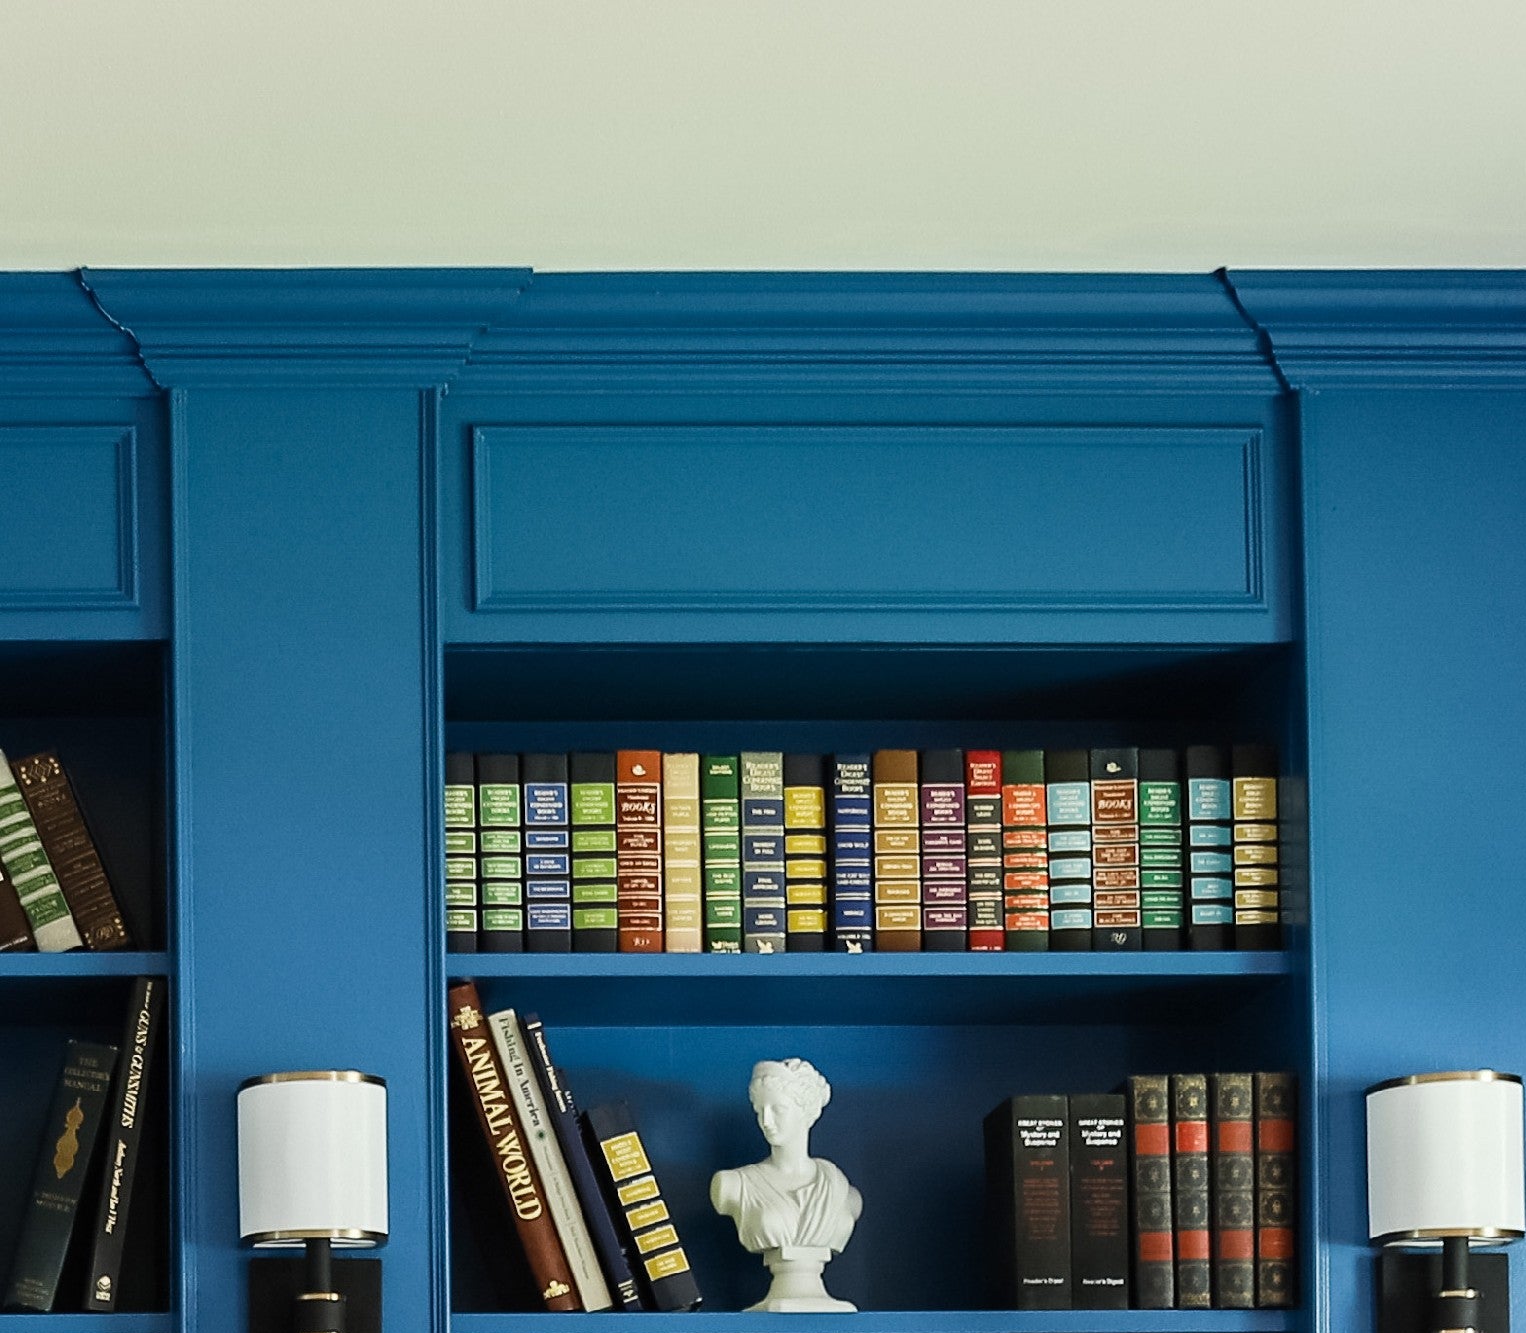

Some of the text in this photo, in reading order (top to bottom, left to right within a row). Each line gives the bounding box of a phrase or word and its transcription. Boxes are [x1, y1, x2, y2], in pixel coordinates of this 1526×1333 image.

[135, 1009, 151, 1046] GUNS
[498, 1017, 521, 1063] Fishing
[518, 1078, 542, 1128] America
[461, 1036, 543, 1221] ANIMAL WORLD
